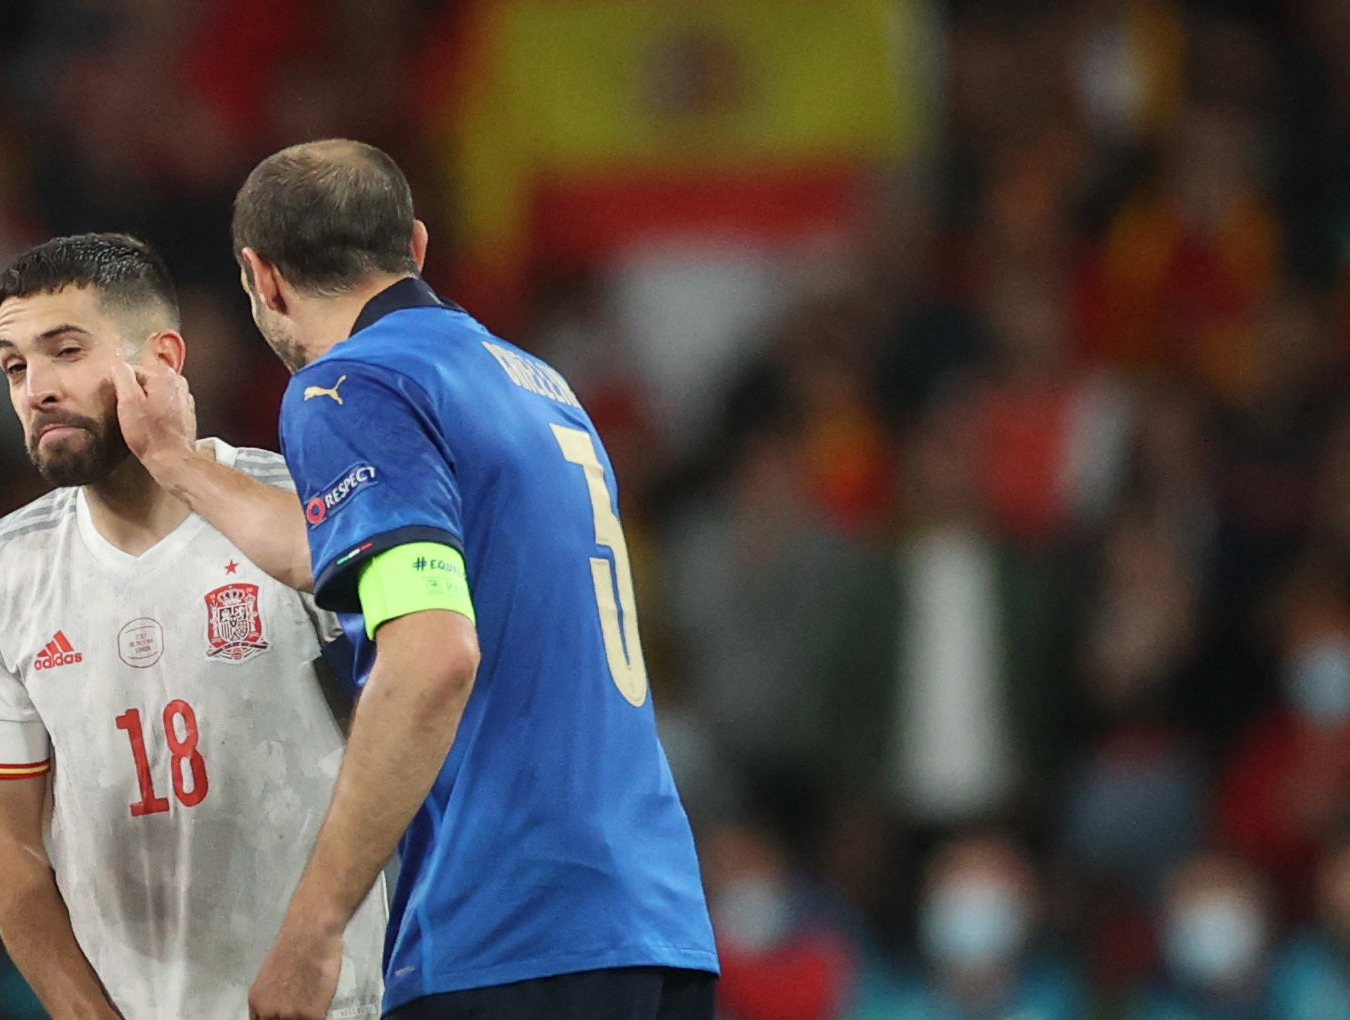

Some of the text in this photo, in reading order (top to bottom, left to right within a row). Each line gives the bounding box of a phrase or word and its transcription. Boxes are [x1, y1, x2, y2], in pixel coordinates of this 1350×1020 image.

[324, 466, 376, 509] RESPECT
[550, 422, 647, 707] 3
[34, 652, 82, 671] adidas
[115, 699, 209, 817] 18
